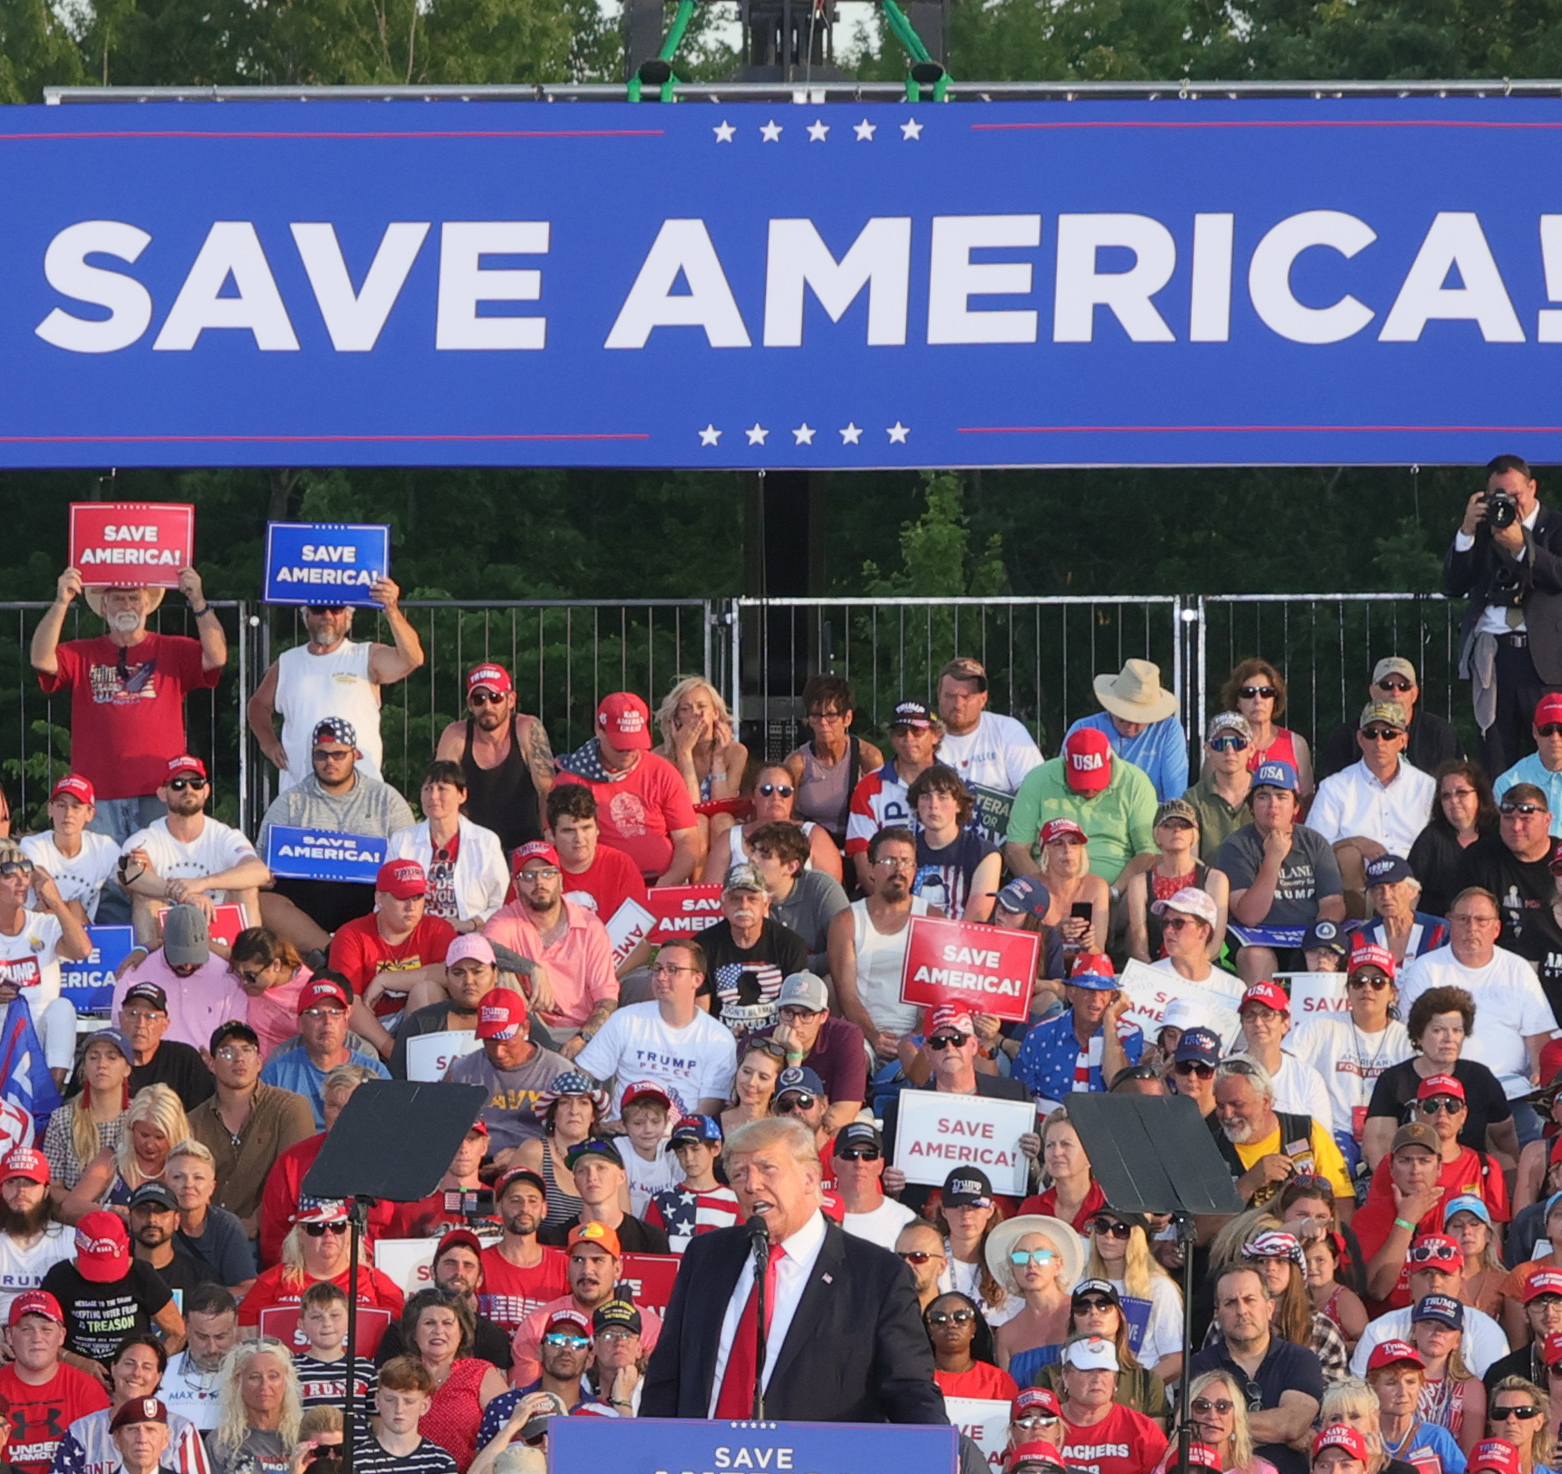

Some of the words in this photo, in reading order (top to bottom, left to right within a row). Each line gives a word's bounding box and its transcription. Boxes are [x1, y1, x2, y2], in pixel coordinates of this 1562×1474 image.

[33, 219, 550, 353] SAVE
[104, 526, 158, 542] SAVE
[80, 548, 181, 566] AMERICA!
[302, 545, 356, 563] SAVE
[276, 568, 379, 586] AMERICA!
[470, 671, 502, 683] TRUMP
[896, 702, 926, 713] TRUMP
[616, 717, 641, 725] AMERICA
[620, 724, 642, 732] GREAT
[1073, 755, 1104, 771] USA
[1259, 766, 1285, 782] USA
[302, 836, 357, 848] SAVE
[278, 848, 380, 863] AMERICA!
[943, 945, 1001, 968] SAVE
[914, 965, 1022, 997] AMERICA!
[1246, 985, 1274, 998] USA
[481, 1006, 510, 1017] Trump
[636, 1050, 697, 1069] TRUMP
[938, 1118, 995, 1139] SAVE
[6, 1155, 37, 1164] AMERICA
[909, 1141, 1017, 1168] AMERICA!
[9, 1162, 35, 1171] GREAT
[952, 1180, 982, 1191] Trump
[1425, 1296, 1457, 1309] TRUMP
[87, 1315, 135, 1333] TREASON
[1382, 1343, 1409, 1354] Trump
[169, 1391, 193, 1400] MAX
[1325, 1427, 1348, 1437] SAVE
[1319, 1436, 1357, 1447] AMERICA
[715, 1447, 793, 1469] SAVE
[1062, 1443, 1129, 1460] ACHERS
